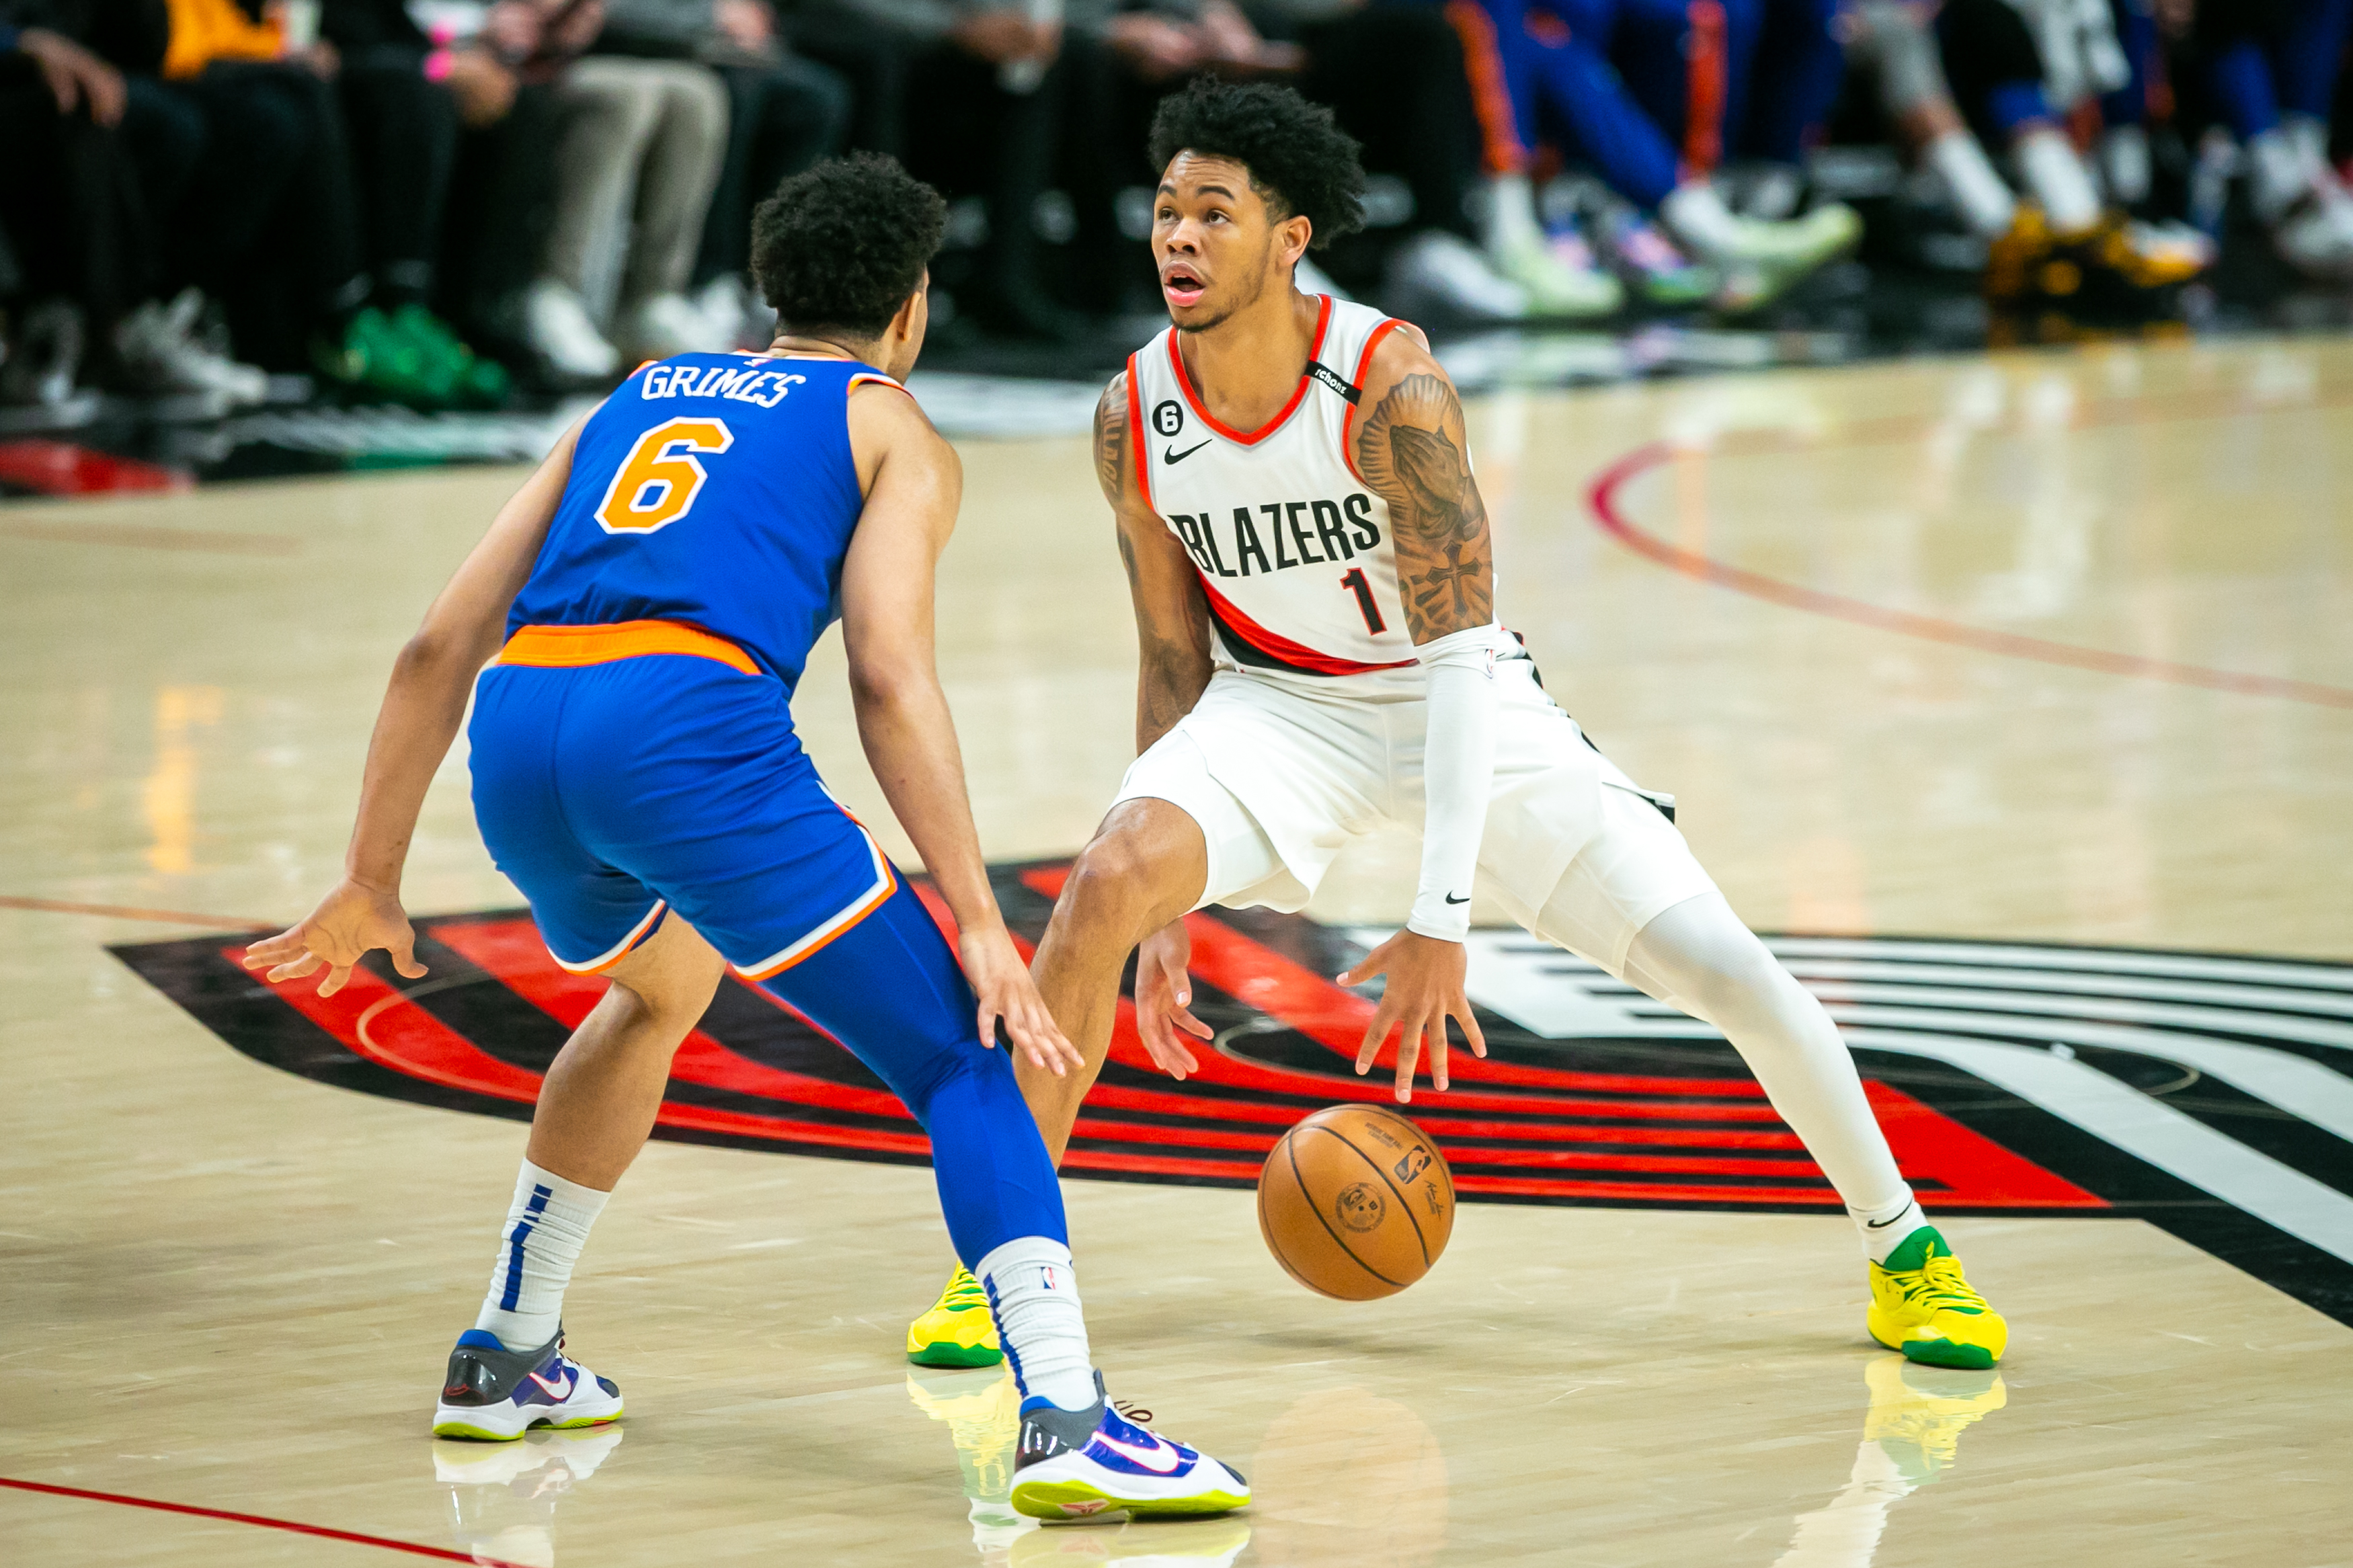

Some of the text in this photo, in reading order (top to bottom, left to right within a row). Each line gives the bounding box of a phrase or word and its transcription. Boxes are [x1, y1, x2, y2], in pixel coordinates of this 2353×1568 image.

[641, 366, 805, 409] GRIMES
[1160, 405, 1178, 434] 6
[594, 417, 734, 534] 6
[1167, 493, 1381, 577] BLAZERS
[1340, 567, 1387, 635] 1
